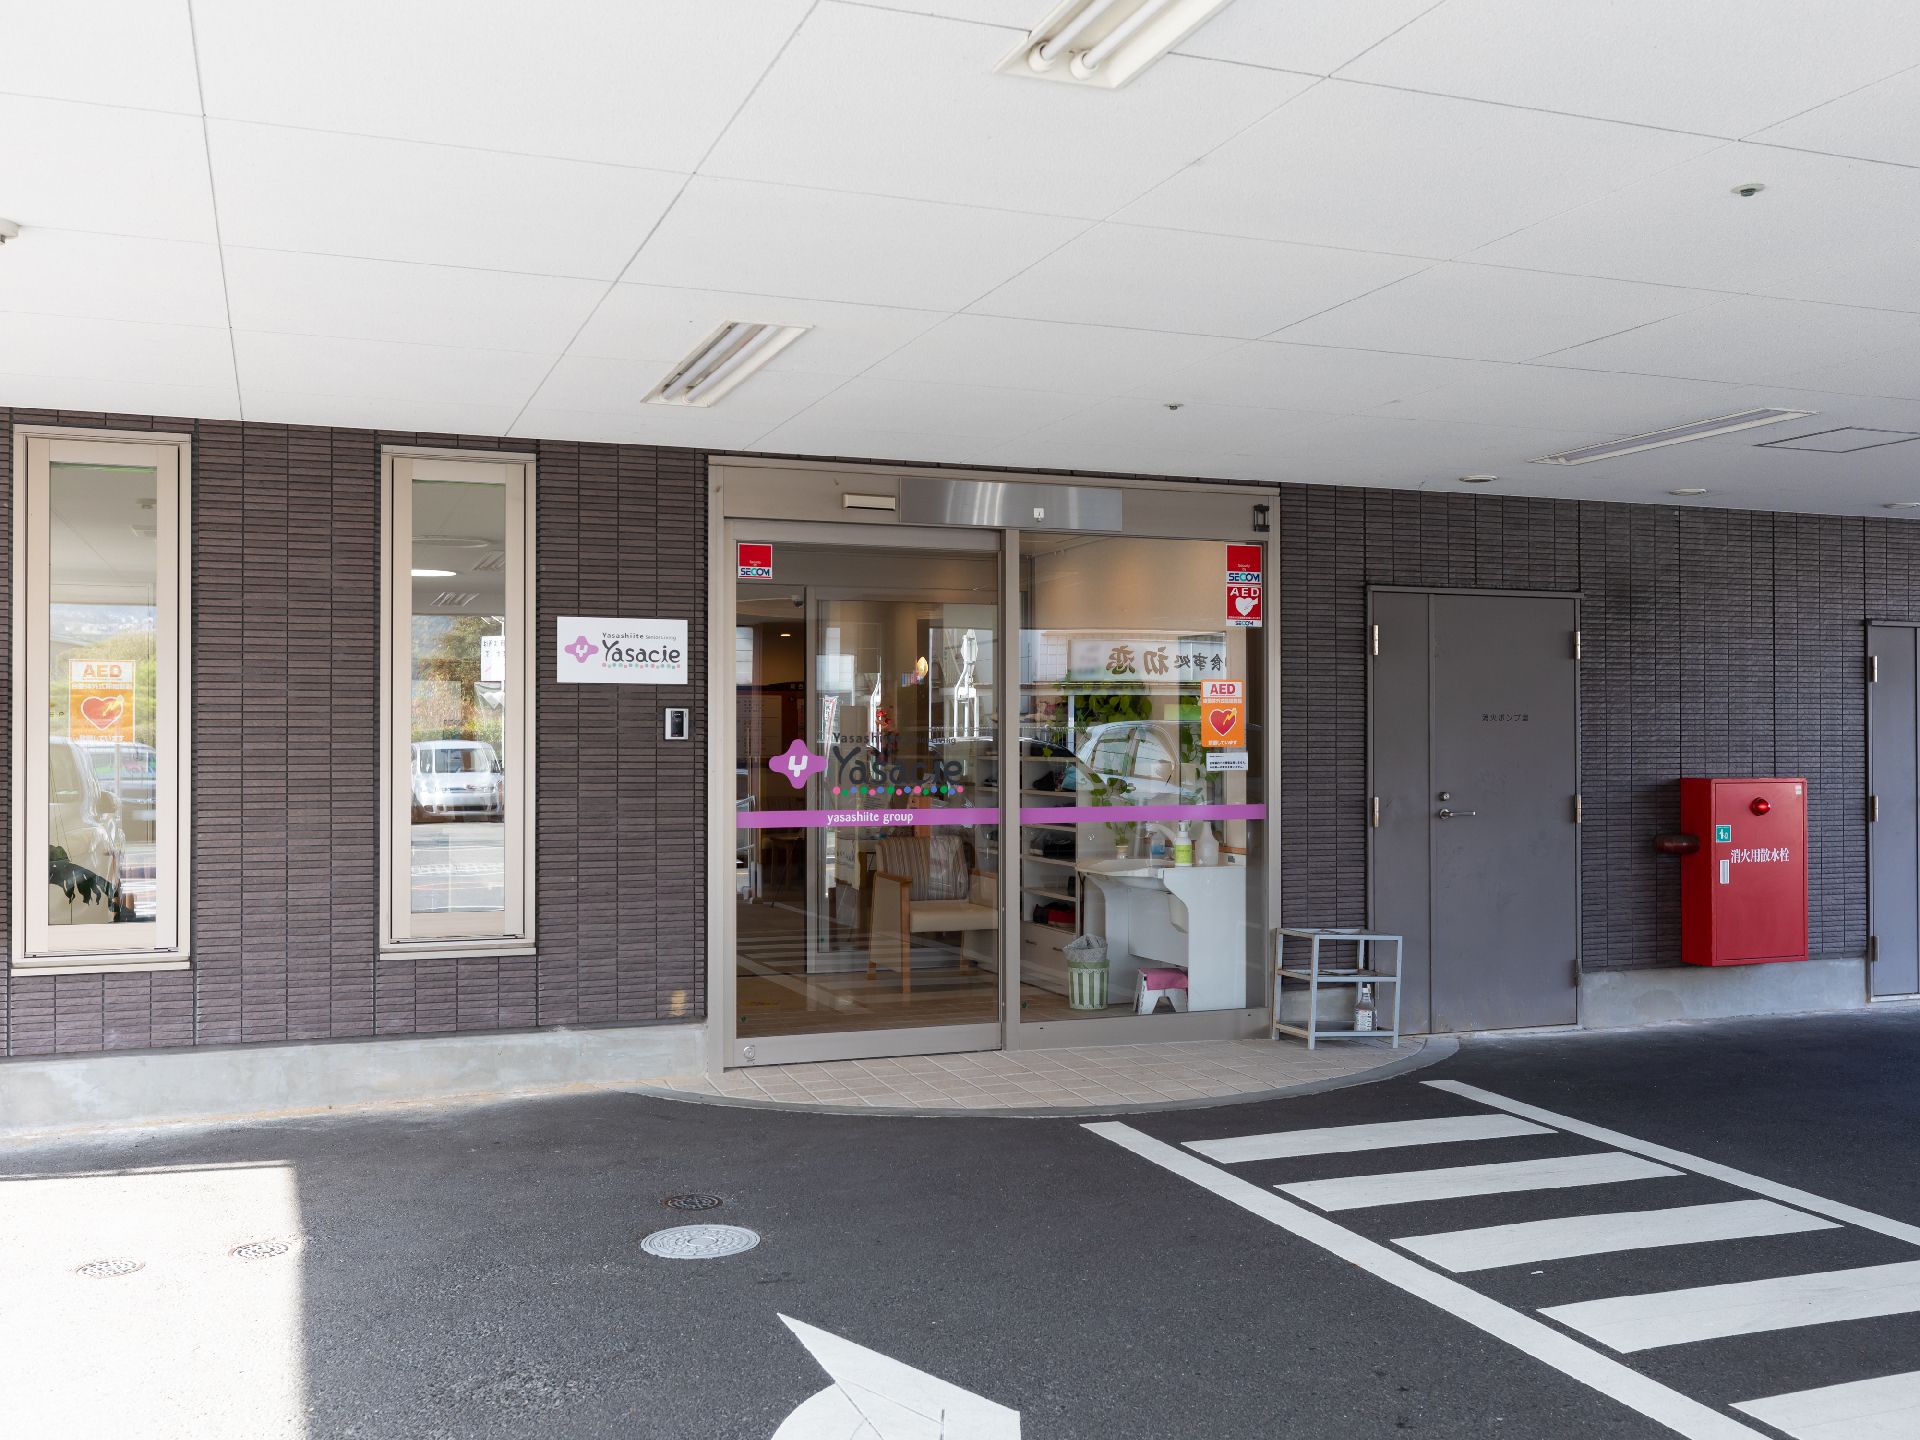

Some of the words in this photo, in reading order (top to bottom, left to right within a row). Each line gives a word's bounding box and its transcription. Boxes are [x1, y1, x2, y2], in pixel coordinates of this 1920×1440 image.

[740, 567, 771, 577] SECOM
[1228, 572, 1261, 583] SECOM
[1229, 587, 1260, 597] AED
[602, 639, 680, 663] Yasacie
[83, 664, 122, 678] AED
[1210, 683, 1236, 695] AED
[832, 745, 964, 785] Yasacie
[827, 811, 880, 825] yasashiite
[883, 812, 914, 825] group
[1730, 847, 1790, 864] 消火用散水栓
